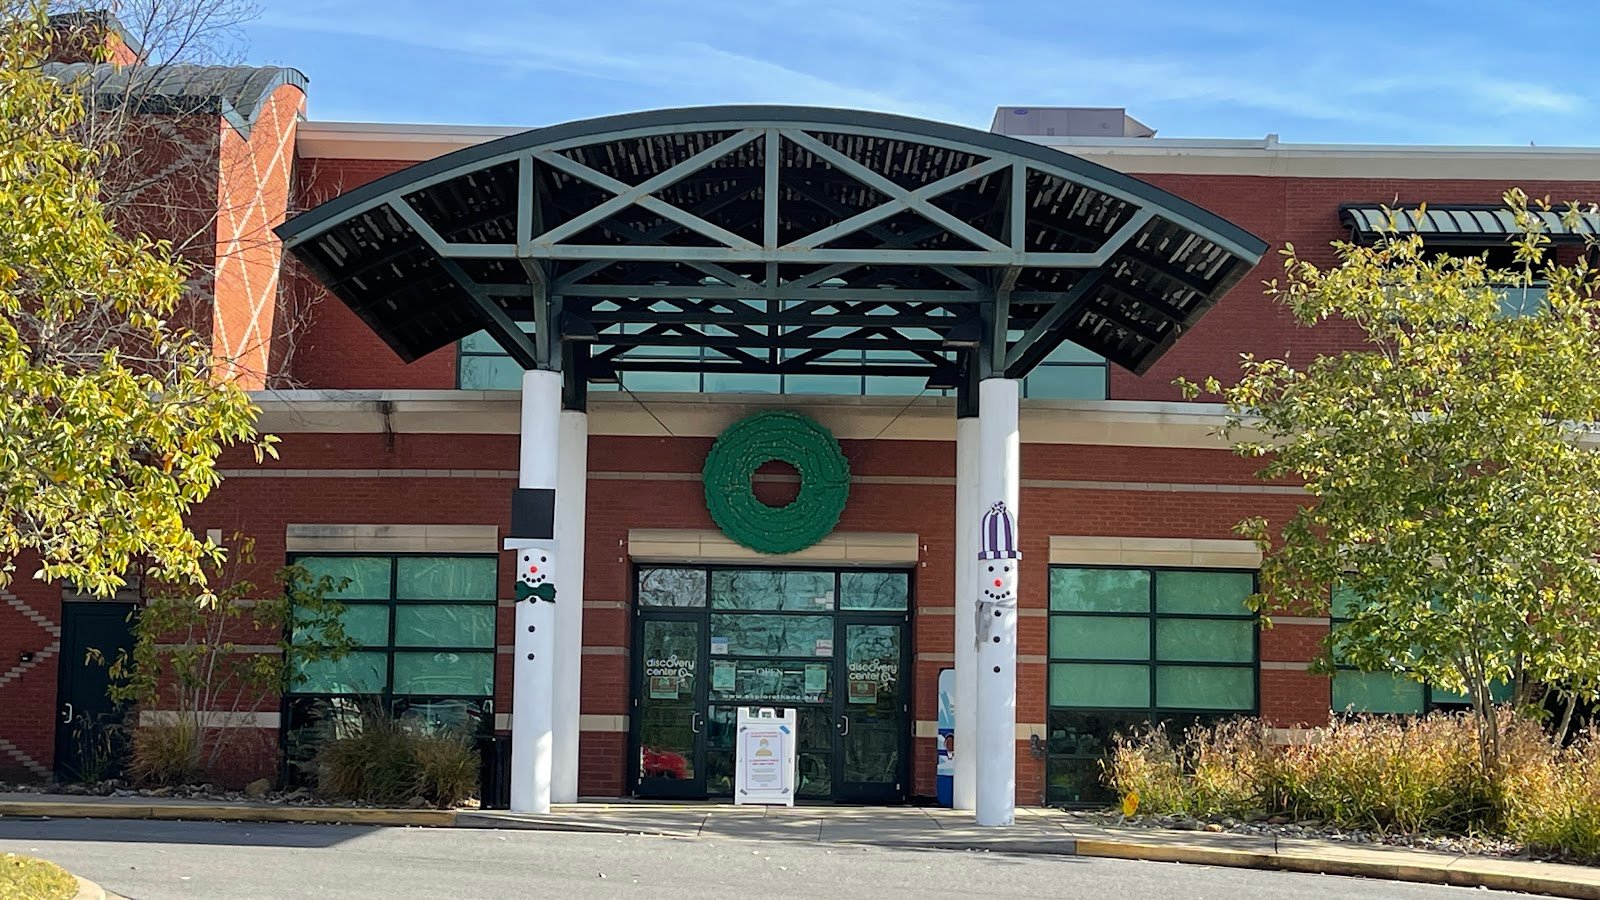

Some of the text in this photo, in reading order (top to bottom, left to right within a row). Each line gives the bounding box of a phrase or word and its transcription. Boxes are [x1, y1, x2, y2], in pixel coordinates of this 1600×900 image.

[646, 656, 695, 670] discovery
[849, 661, 898, 675] discovery
[646, 668, 678, 676] center
[756, 667, 784, 677] OPEN
[849, 672, 880, 680] center
